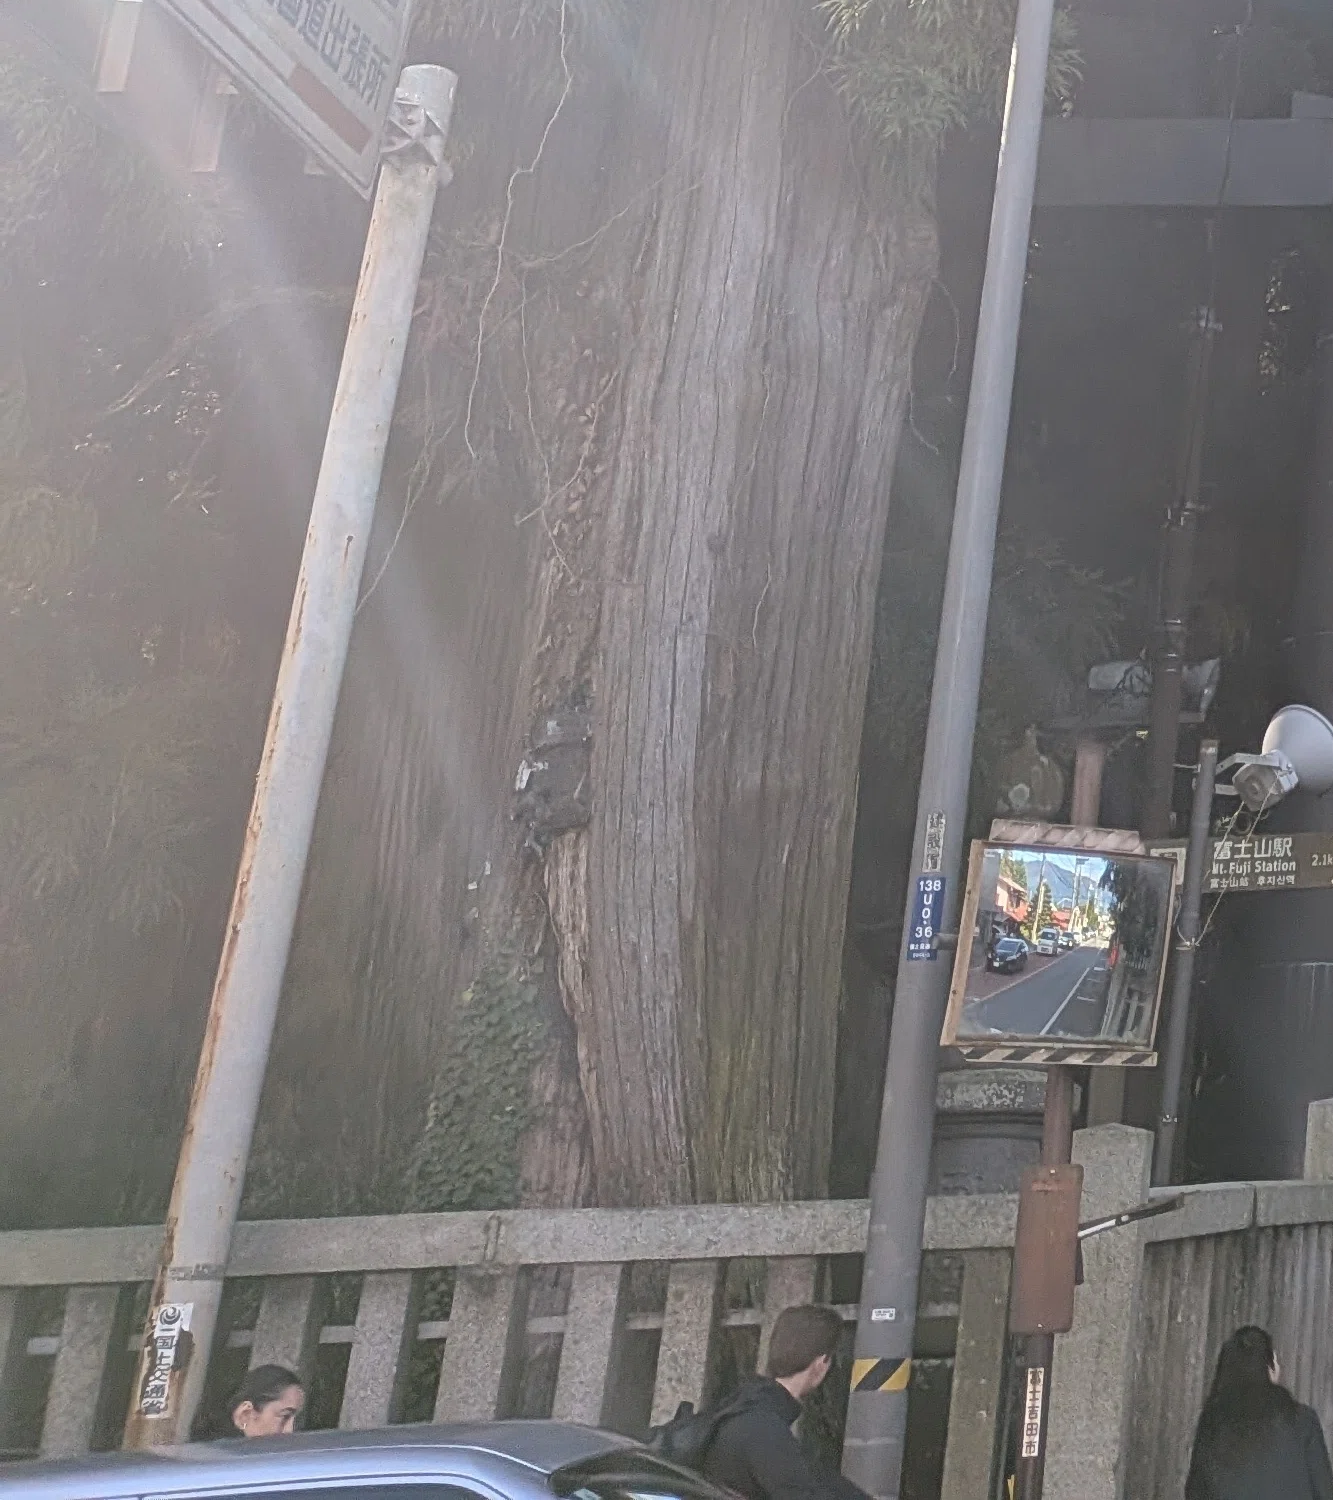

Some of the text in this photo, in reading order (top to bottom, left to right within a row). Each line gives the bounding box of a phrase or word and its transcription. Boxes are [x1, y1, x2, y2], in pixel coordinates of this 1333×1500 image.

[1213, 837, 1293, 860] 富士山駅
[1229, 862, 1251, 877] Fuji
[1254, 860, 1297, 873] Station
[919, 879, 942, 892] 138
[914, 926, 933, 939] 36
[1024, 1367, 1043, 1455] 富士吉田市
